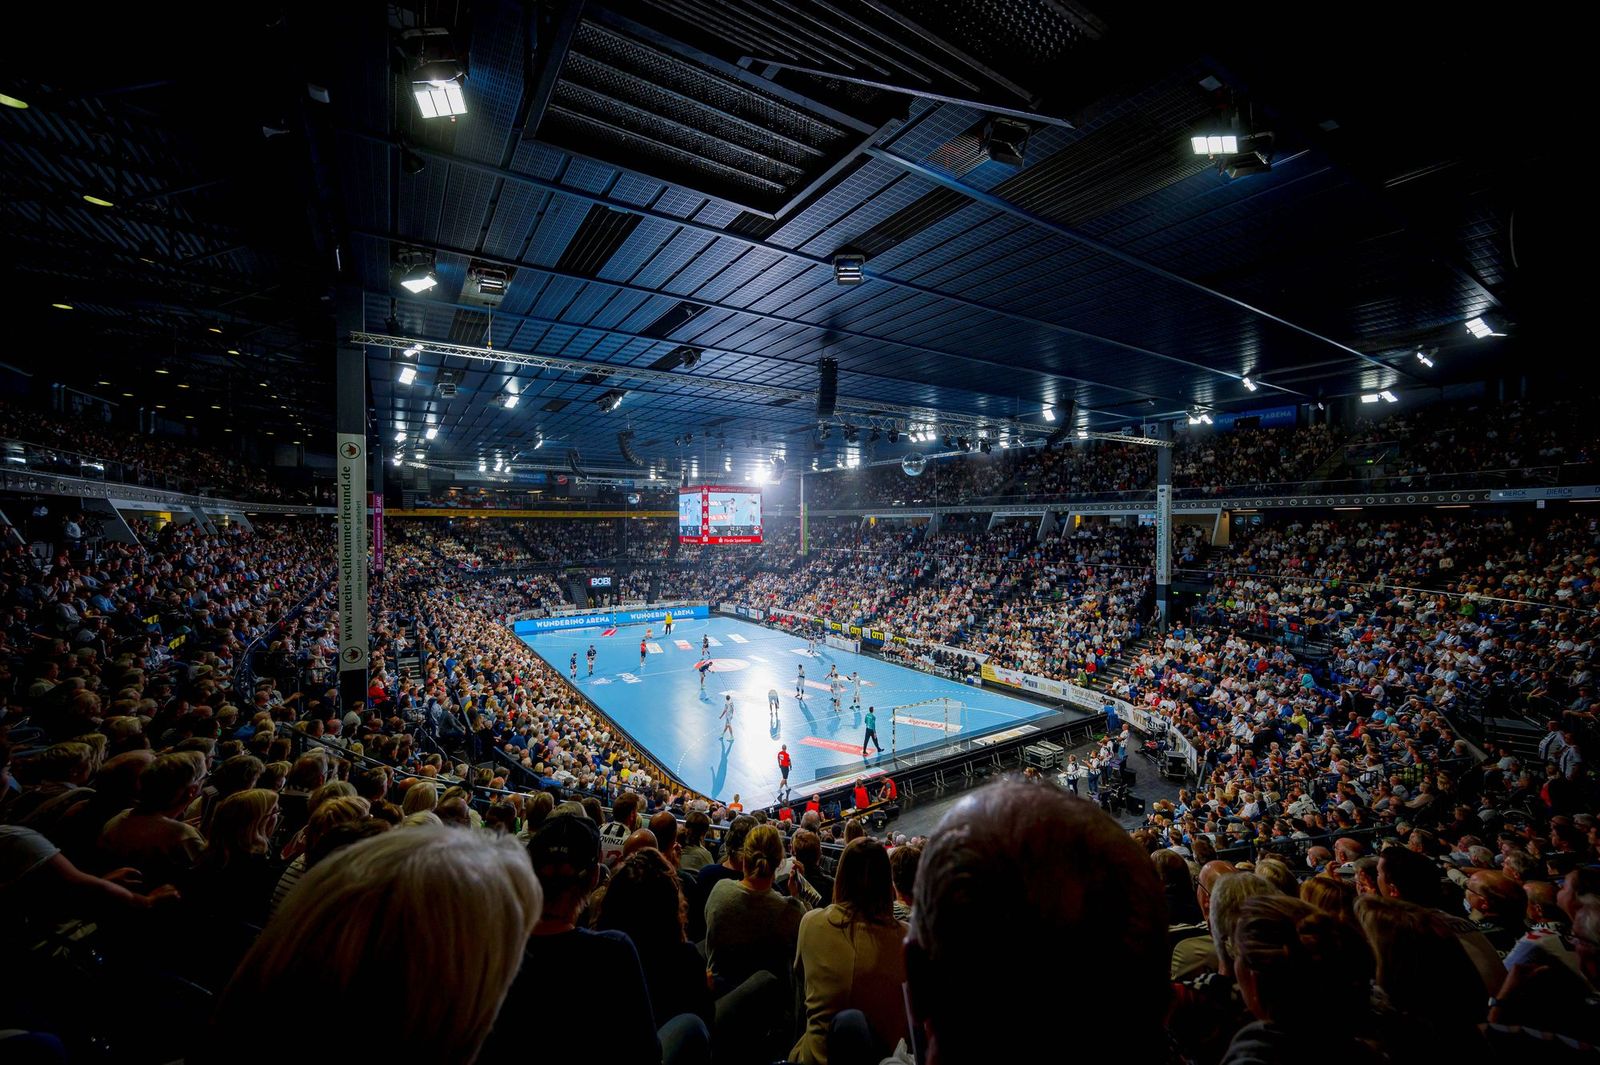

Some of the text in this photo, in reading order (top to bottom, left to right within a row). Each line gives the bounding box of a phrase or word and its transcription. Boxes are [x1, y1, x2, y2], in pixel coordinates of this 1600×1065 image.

[1546, 487, 1573, 495] DIERCK
[341, 465, 353, 641] www.mein-schlemmerfreund.de
[674, 609, 694, 617] ARENA
[536, 616, 610, 628] WUNDERINO ARENA
[872, 631, 884, 640] CITTI
